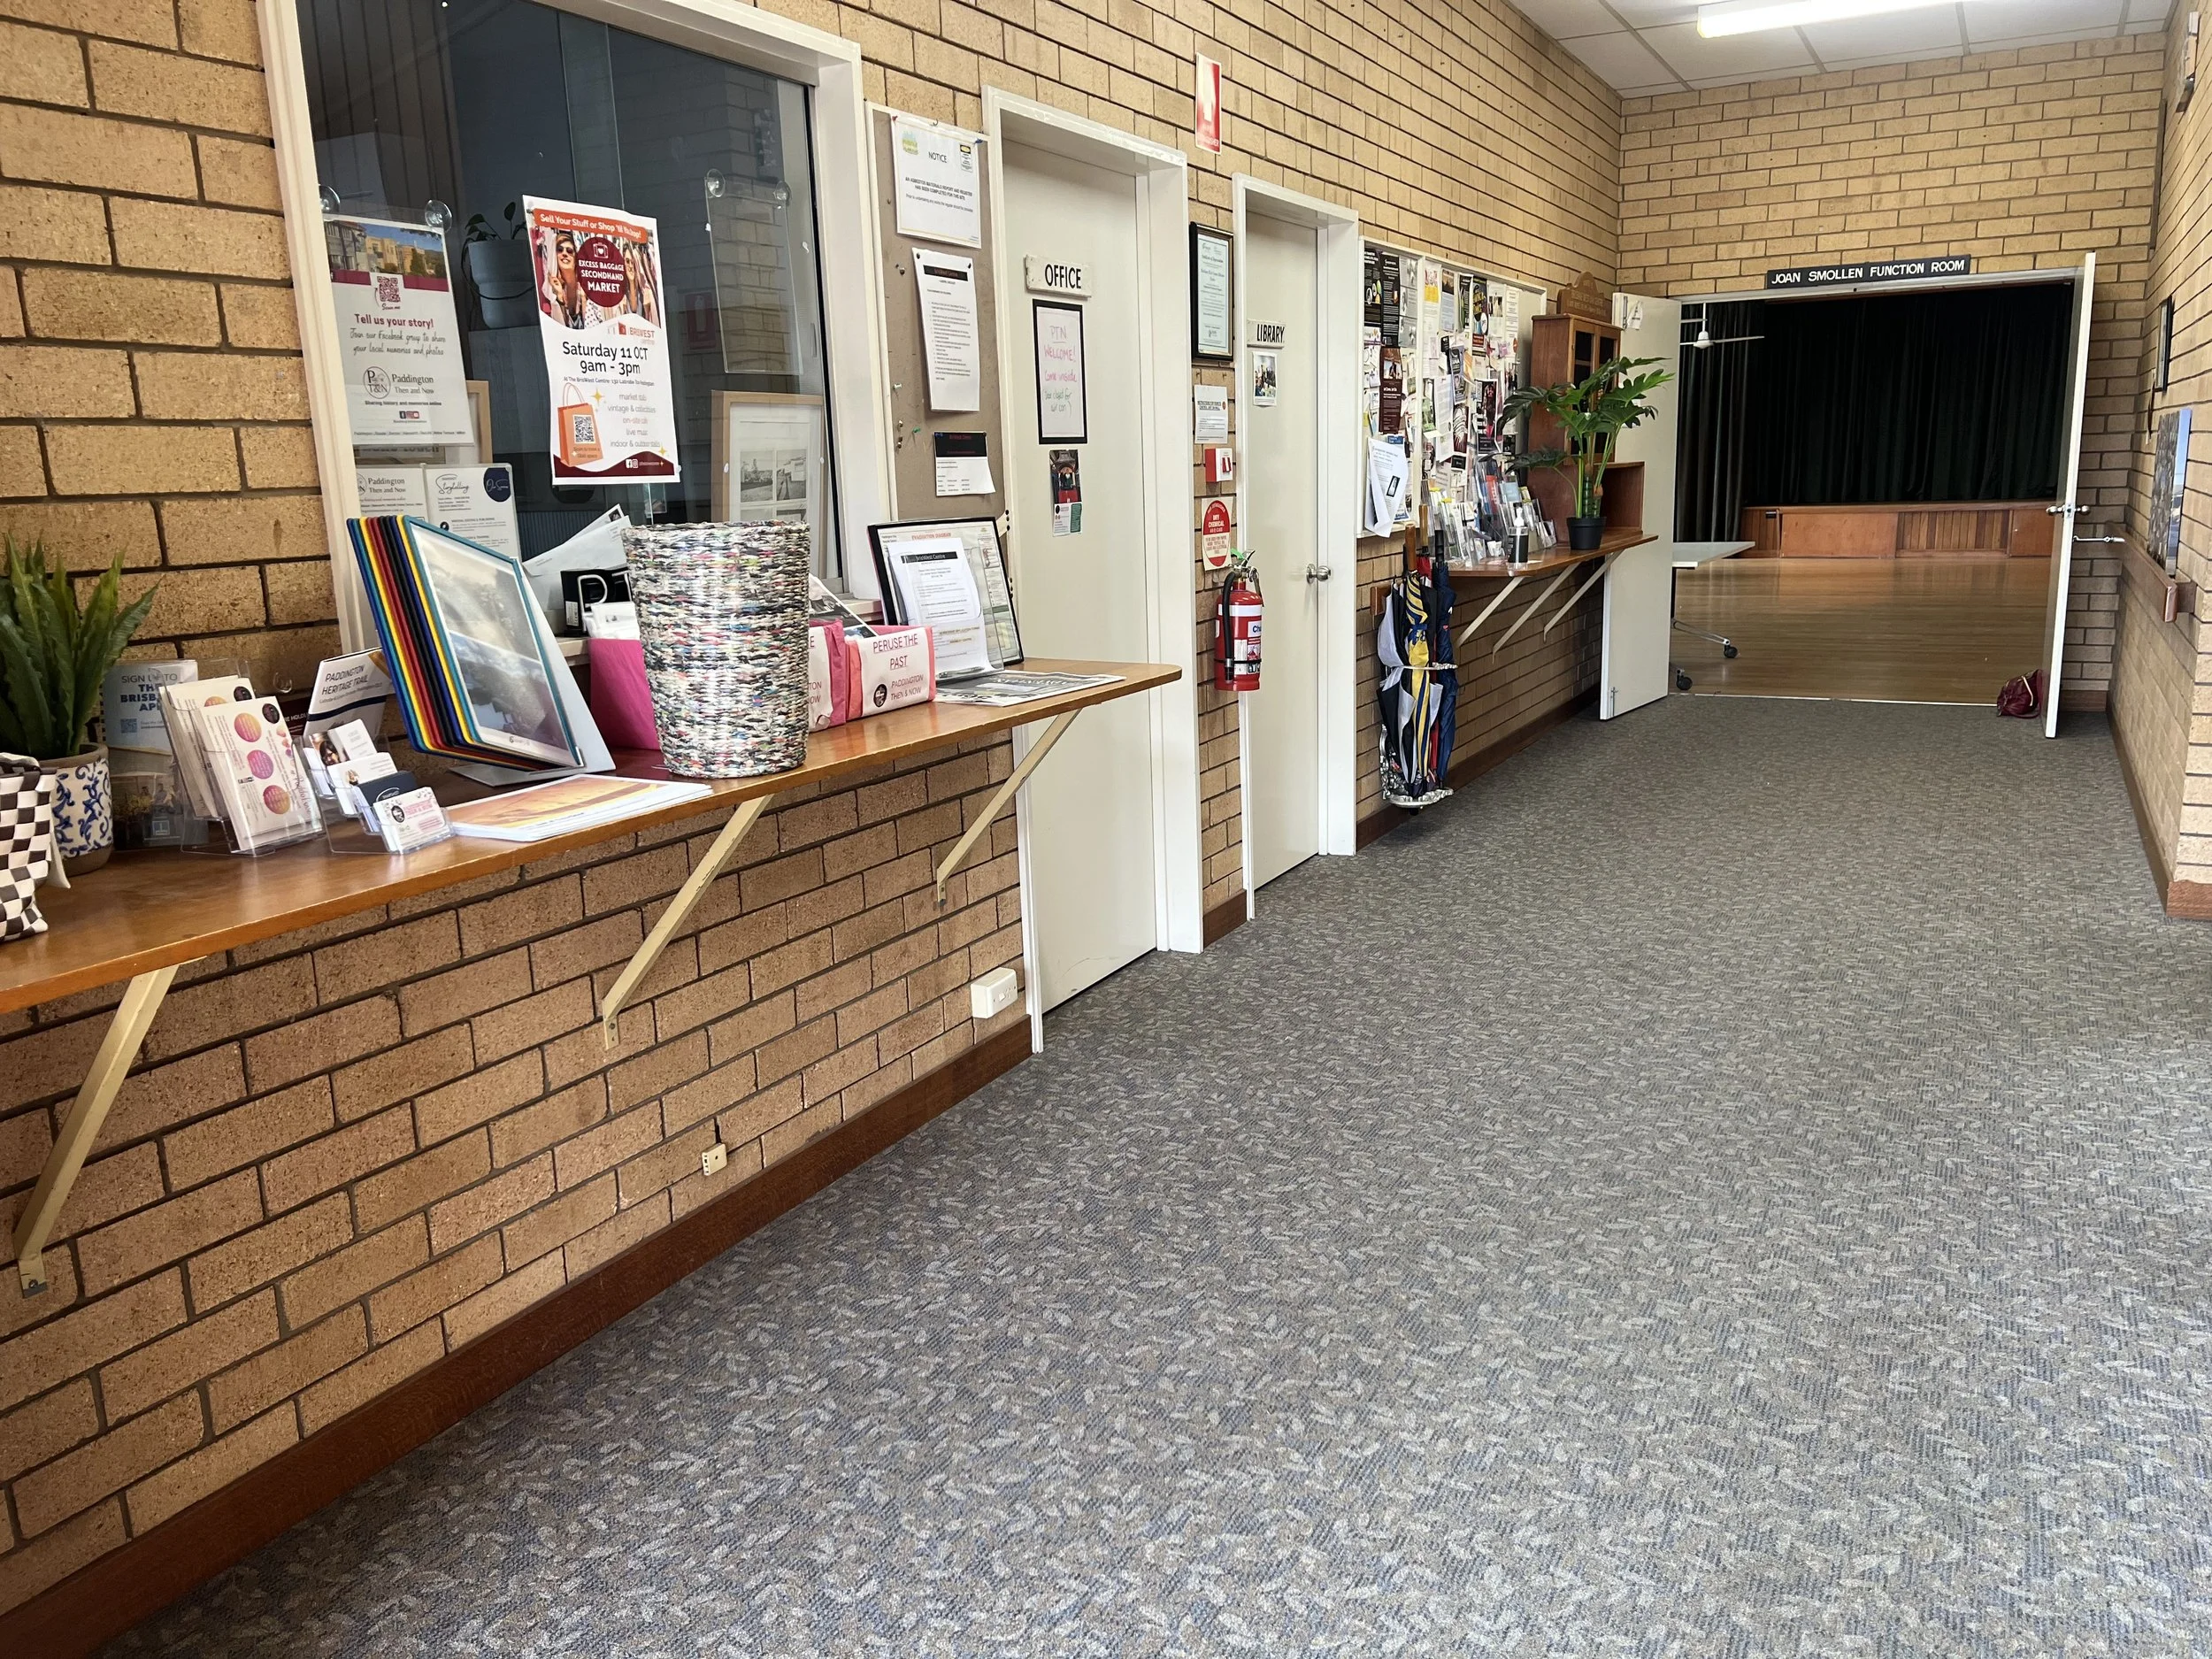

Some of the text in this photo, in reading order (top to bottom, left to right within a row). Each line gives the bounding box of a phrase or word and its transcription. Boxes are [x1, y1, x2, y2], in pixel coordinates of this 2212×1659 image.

[928, 151, 948, 164] NOTICE
[540, 213, 555, 224] Sell
[555, 215, 571, 226] Your
[572, 218, 588, 228] Stuff
[598, 221, 615, 232] Shop
[578, 260, 625, 272] EXCESS BAGGAGE
[1771, 259, 1966, 285] JOAN SMOLLEN FUNCTION ROOM
[580, 270, 624, 281] SECONDHAND
[1044, 264, 1082, 289] OFFICE
[588, 281, 620, 294] MARKET
[354, 313, 434, 329] Tell us your story!
[378, 329, 403, 341] Facebook
[405, 334, 421, 345] group
[431, 331, 446, 342] share
[1256, 323, 1286, 344] LIBRARY
[353, 345, 367, 356] your
[425, 343, 444, 357] photos
[562, 341, 649, 362] Saturday 11 OCT
[1043, 343, 1077, 363] WELCOME!
[580, 360, 607, 373] 9am
[618, 362, 641, 377] 3pm
[391, 373, 434, 386] Paddington
[395, 386, 409, 395] Then
[608, 405, 629, 414] vintage
[367, 477, 405, 487] Paddington
[872, 634, 918, 653] PERUSE THE
[889, 655, 909, 670] PAST
[121, 673, 145, 684] SIGN
[164, 672, 178, 681] TO
[325, 665, 365, 682] PADDINGTON
[891, 674, 925, 688] PADDINGTON
[321, 674, 368, 695] HERITAGE TRAIL
[890, 692, 904, 701] THEN
[908, 687, 922, 695] NOW
